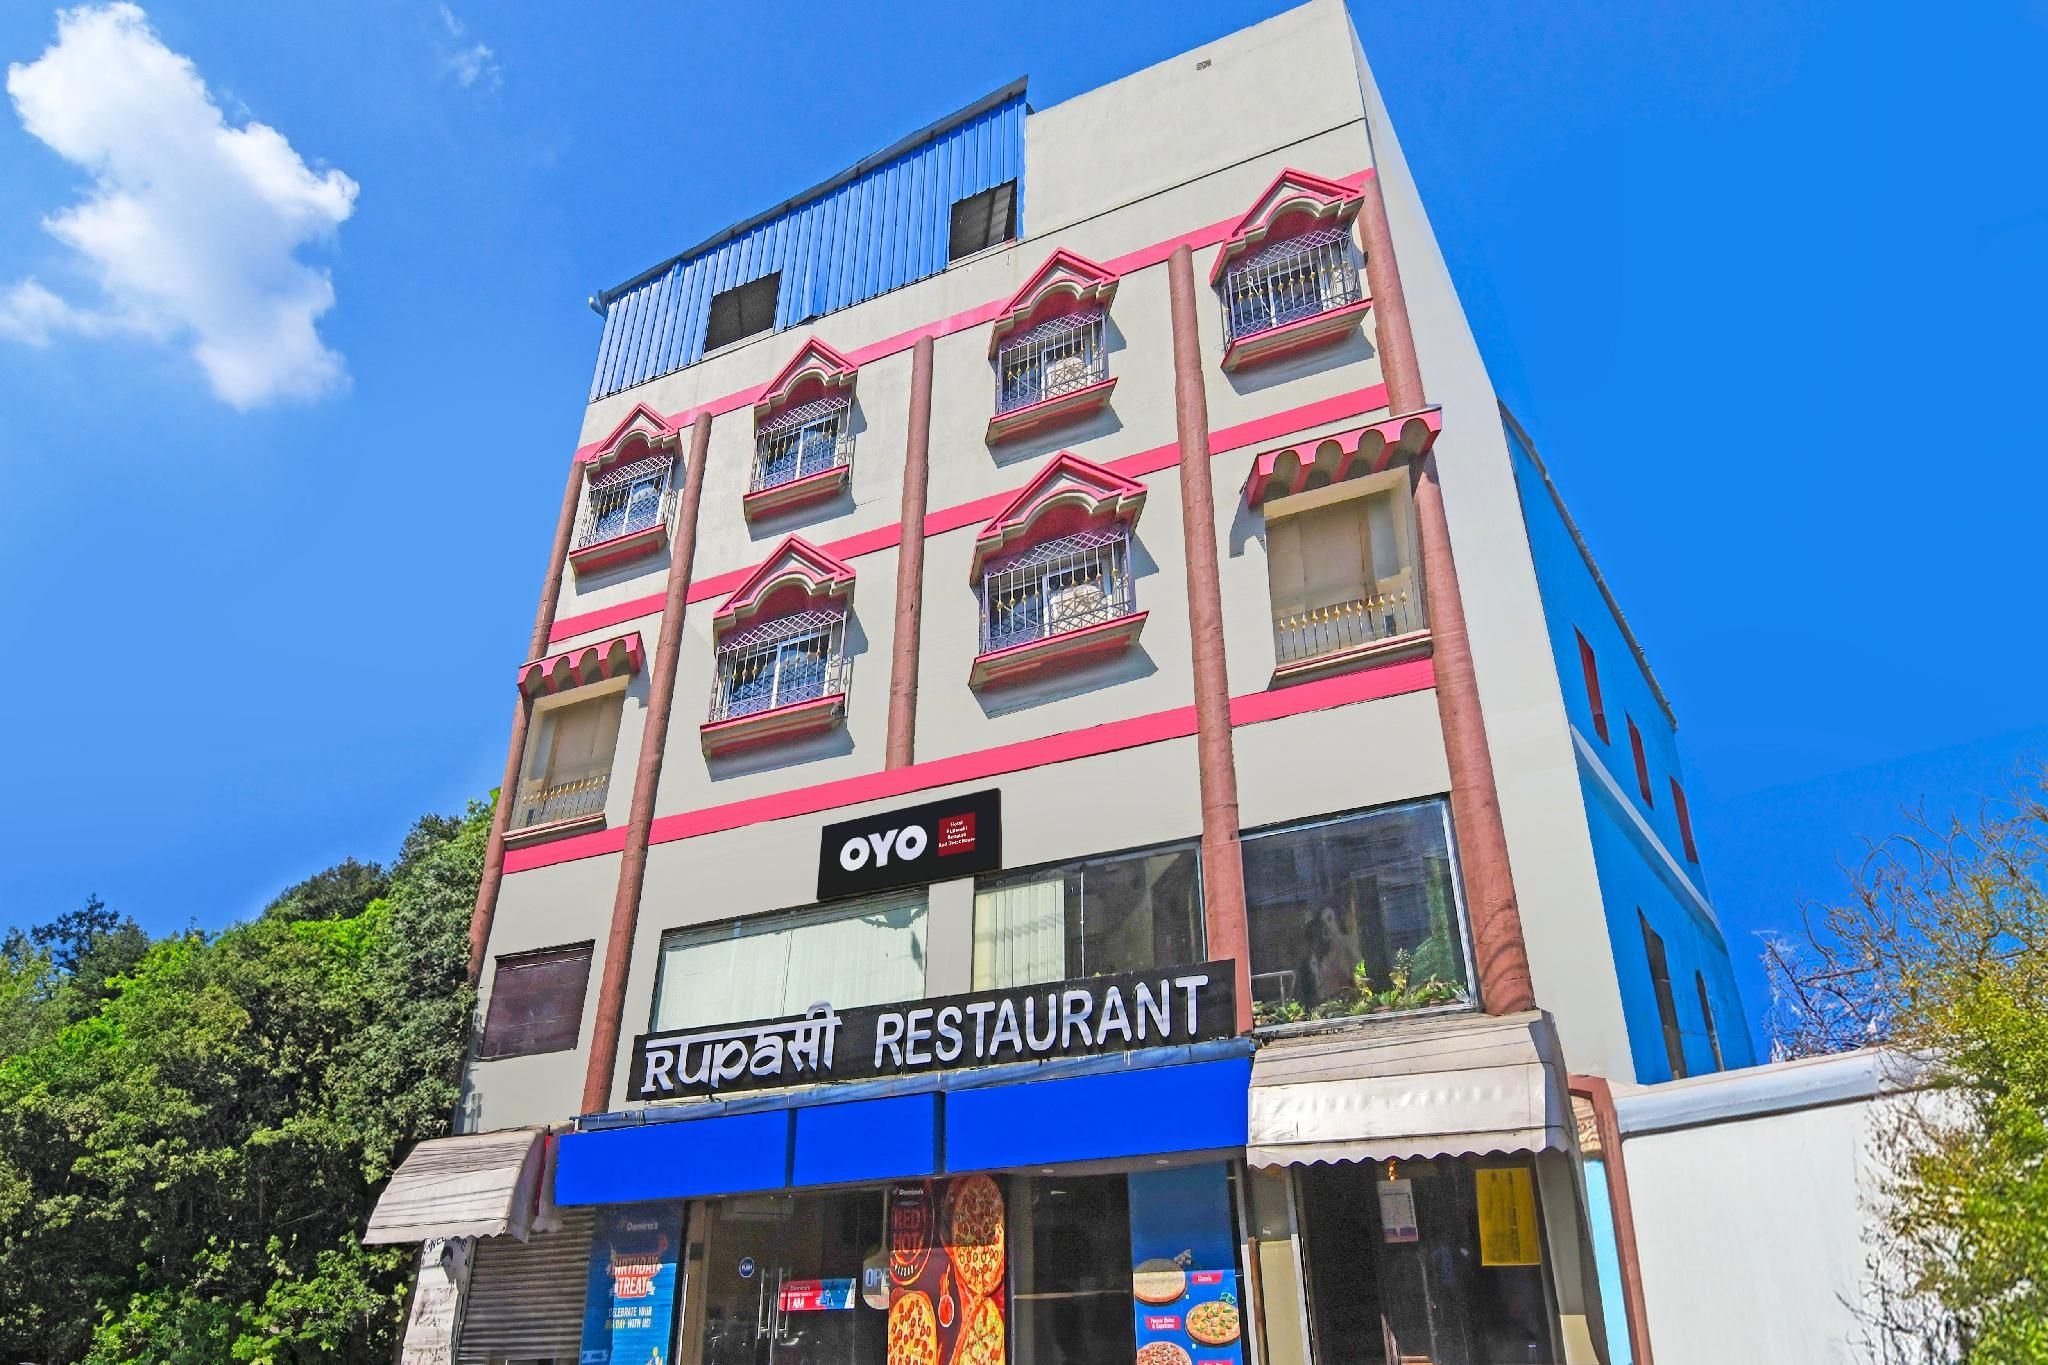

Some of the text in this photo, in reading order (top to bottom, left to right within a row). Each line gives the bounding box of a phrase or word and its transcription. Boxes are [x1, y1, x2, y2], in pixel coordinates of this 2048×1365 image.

[839, 825, 928, 872] OYO
[873, 974, 1209, 1070] RESTAURANT
[612, 1255, 659, 1275] BIRTHDAY
[618, 1276, 648, 1294] TREAT
[608, 1306, 638, 1318] CELEBRATE
